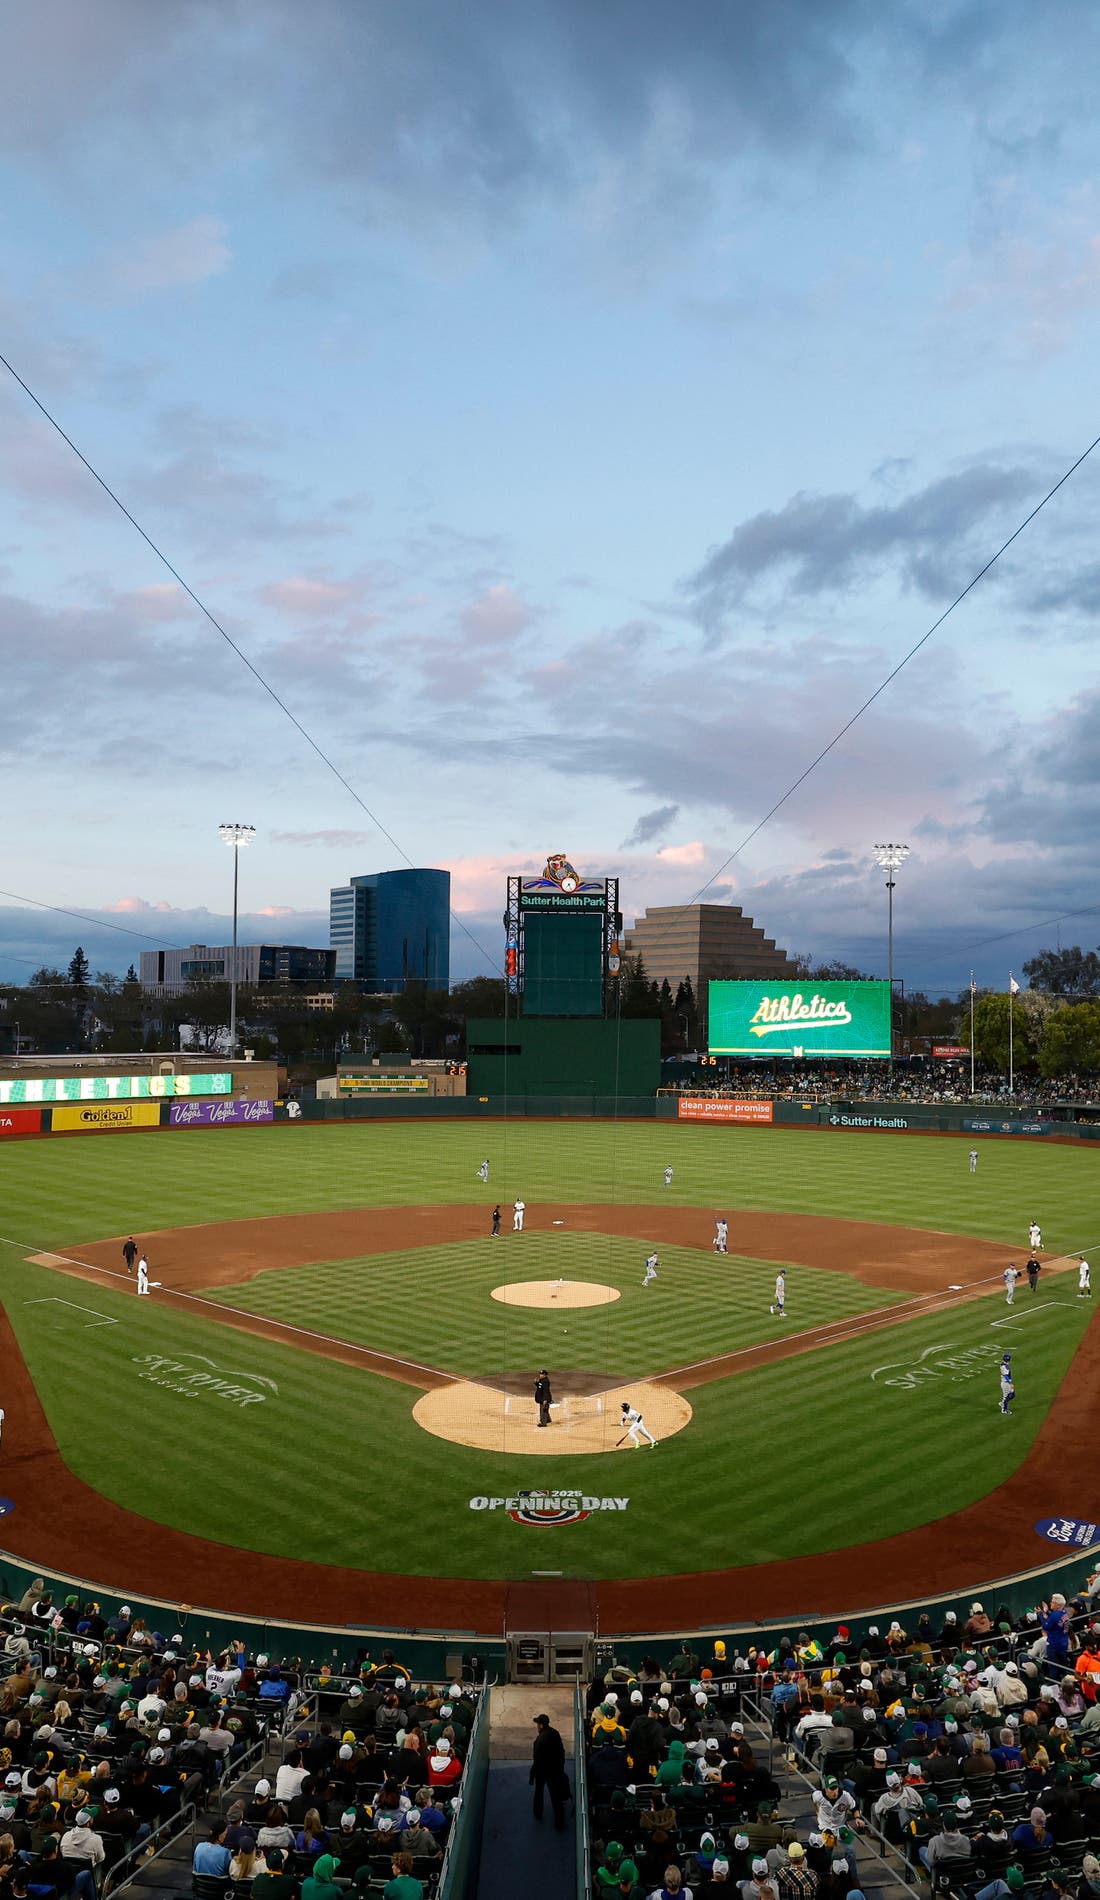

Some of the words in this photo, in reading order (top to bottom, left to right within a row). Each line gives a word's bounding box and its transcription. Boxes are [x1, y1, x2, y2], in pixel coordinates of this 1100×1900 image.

[521, 896, 551, 906] Sutter
[552, 896, 583, 906] Health
[583, 897, 606, 907] Park
[749, 994, 848, 1024] Athletics
[171, 1105, 204, 1123] Vegas
[206, 1104, 238, 1122] Vegas
[241, 1103, 273, 1121] Vegas
[681, 1101, 703, 1109] clean
[705, 1103, 732, 1111] power
[735, 1103, 770, 1113] promise
[0, 1118, 13, 1127] TA
[840, 1115, 872, 1127] Sutter
[874, 1116, 908, 1128] Health
[884, 1367, 943, 1390] SKY
[933, 1344, 1018, 1370] RIVER
[132, 1354, 193, 1373] SKY
[180, 1372, 267, 1407] RIVER
[138, 1372, 200, 1398] CASINO
[469, 1496, 578, 1511] OPENING
[582, 1496, 631, 1511] DAY
[1047, 1519, 1077, 1542] Ford
[211, 1682, 218, 1691] 2
